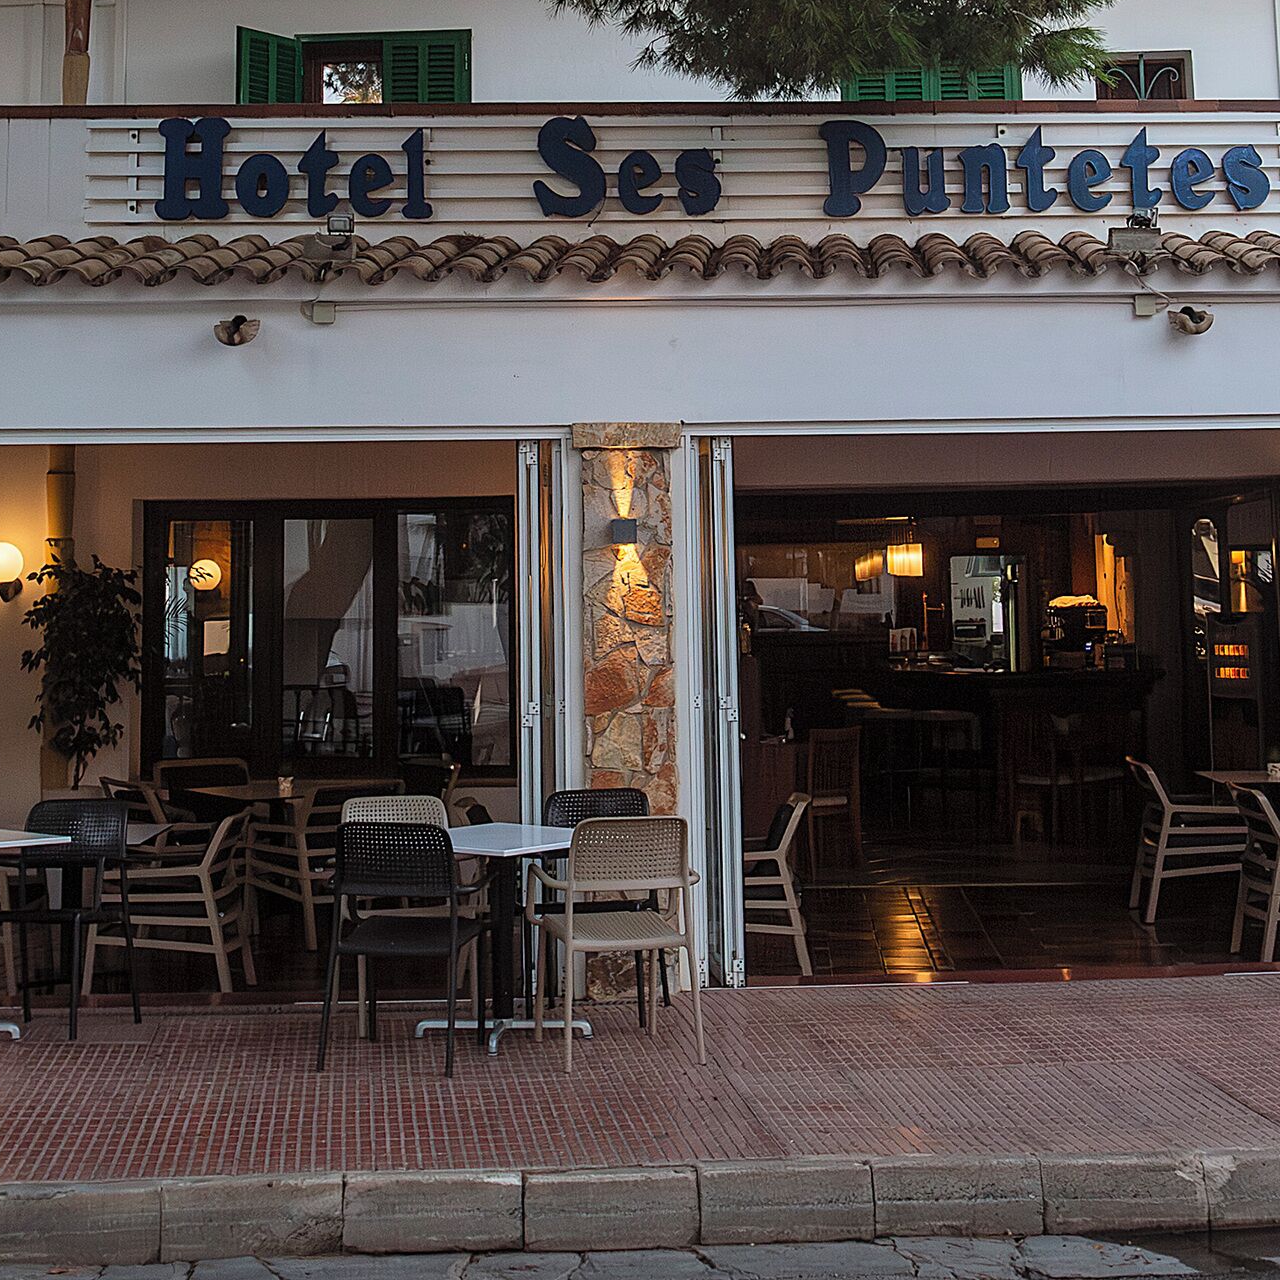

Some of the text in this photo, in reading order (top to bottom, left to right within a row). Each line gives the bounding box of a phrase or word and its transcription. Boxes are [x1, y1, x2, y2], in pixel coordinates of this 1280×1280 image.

[154, 116, 1271, 220] Hotel Ses Puntetes
